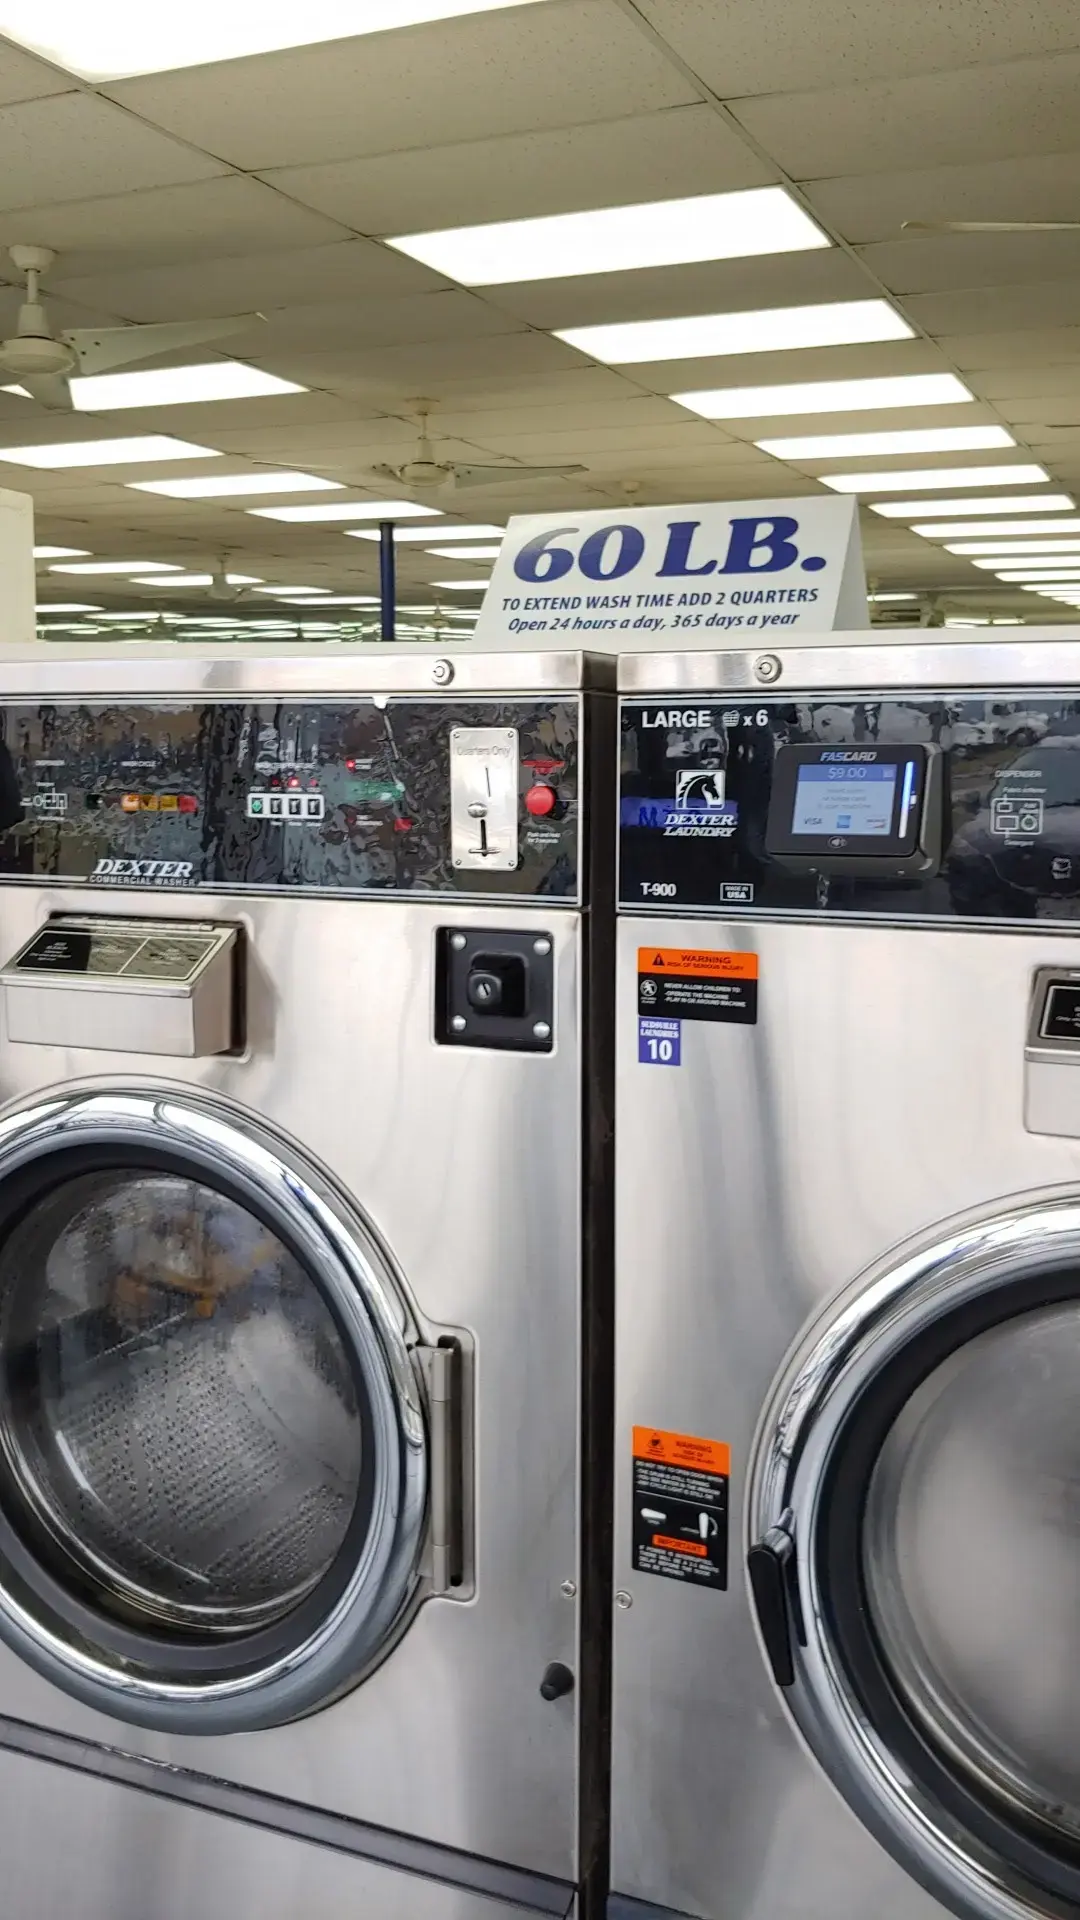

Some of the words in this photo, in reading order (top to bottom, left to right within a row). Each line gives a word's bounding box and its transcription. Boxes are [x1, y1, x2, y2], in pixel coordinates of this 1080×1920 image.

[513, 525, 645, 583] 60
[656, 516, 826, 577] LB.
[503, 598, 520, 611] TO
[524, 596, 581, 610] EXTEND
[586, 594, 630, 609] WASH
[636, 593, 673, 608] TIME
[678, 592, 712, 606] ADD
[716, 592, 725, 606] 2
[730, 588, 818, 606] QUARTERS
[508, 617, 547, 634] Open
[550, 617, 569, 631] 24
[572, 615, 616, 630] hours
[619, 618, 631, 629] a
[633, 615, 666, 632] day,
[671, 613, 700, 628] 365
[705, 612, 743, 629] days
[747, 615, 757, 625] a
[759, 612, 800, 628] year
[642, 710, 712, 728] LARGE
[743, 715, 753, 726] x
[756, 709, 768, 727] 6
[492, 745, 511, 758] Only
[819, 751, 877, 762] FASCARD
[827, 767, 867, 779] $9.00
[994, 769, 1042, 778] DISPENSER
[664, 813, 735, 826] DEXTER
[804, 817, 823, 825] VISA
[663, 826, 737, 837] LAUNDRY
[92, 858, 194, 878] DEXTER
[89, 875, 151, 886] COMMERCIAL
[154, 878, 196, 887] WASHER
[640, 882, 676, 896] T-900
[727, 891, 747, 899] USA
[681, 954, 731, 964] WARNING
[647, 1038, 672, 1061] 10
